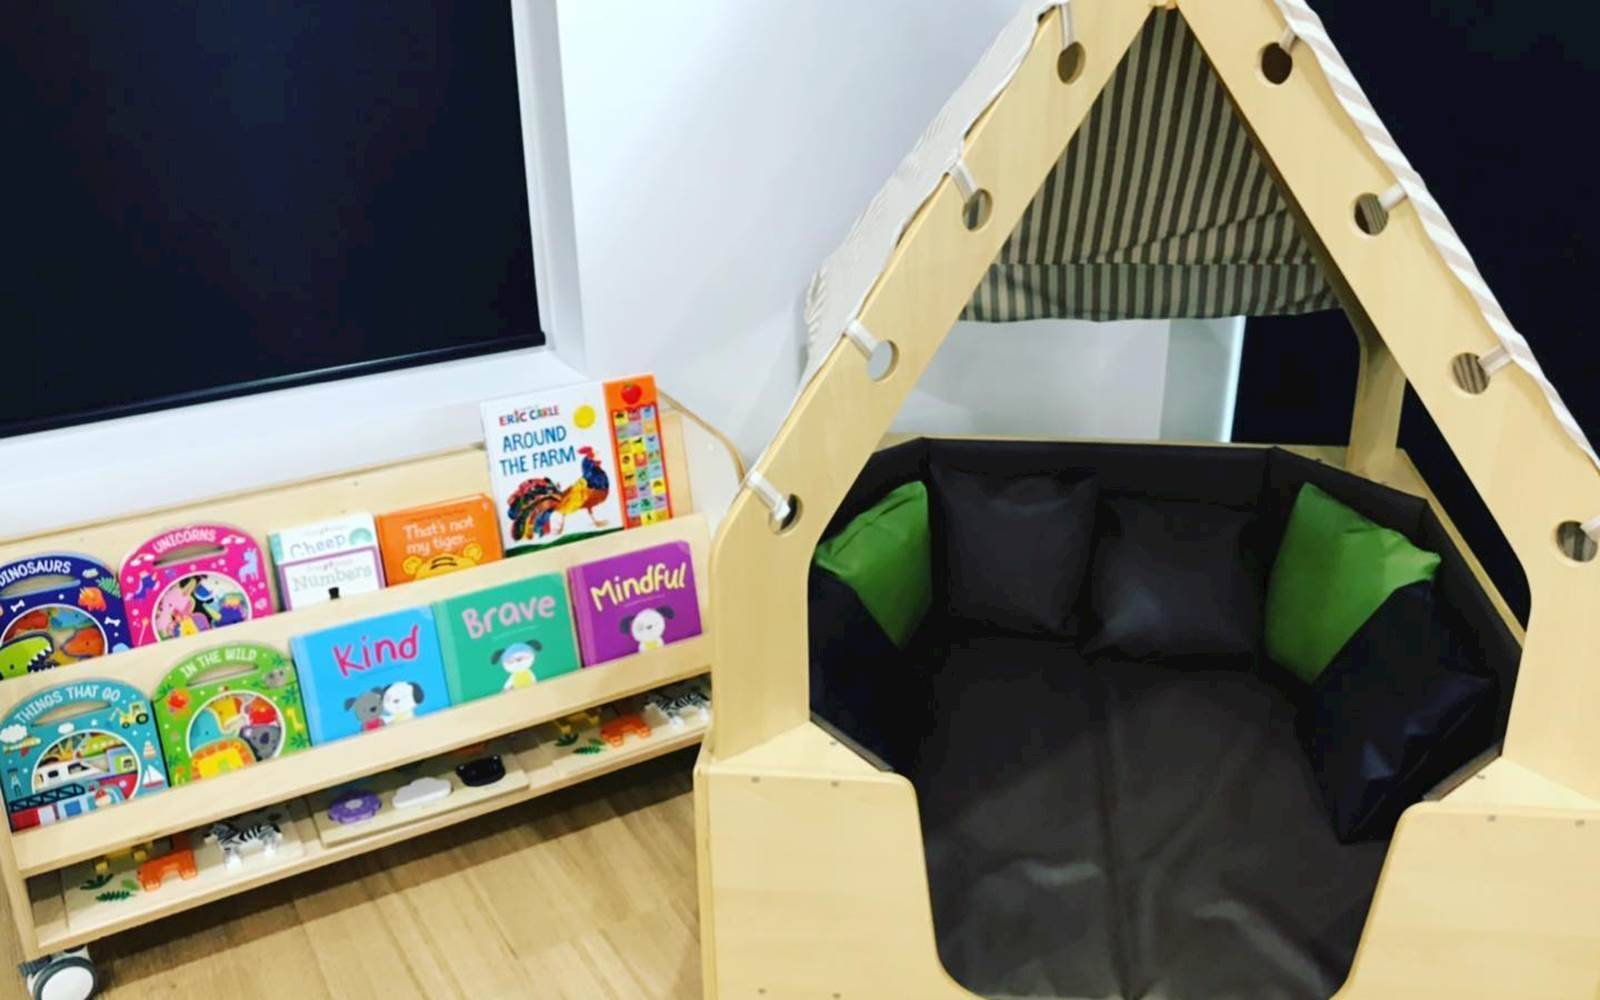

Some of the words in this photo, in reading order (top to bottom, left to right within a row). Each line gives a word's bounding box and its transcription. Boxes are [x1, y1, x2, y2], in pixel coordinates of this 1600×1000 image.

[499, 410, 527, 427] ERIC
[502, 425, 567, 453] AROUND
[500, 454, 530, 476] THE
[532, 446, 576, 469] FARM
[153, 529, 216, 553] UNICORNS
[402, 520, 446, 540] That's
[449, 515, 475, 530] not
[290, 533, 346, 559] Cheep
[406, 541, 431, 557] my
[0, 559, 72, 587] DINOSAURS
[291, 565, 373, 592] Numbers
[591, 562, 687, 613] Mindful
[462, 594, 557, 640] Brave
[180, 664, 198, 679] IN
[200, 653, 222, 667] THE
[225, 648, 257, 662] WILD
[333, 624, 420, 678] Kind
[15, 691, 63, 725] THINGS
[65, 685, 99, 701] THAT
[101, 686, 121, 701] GO
